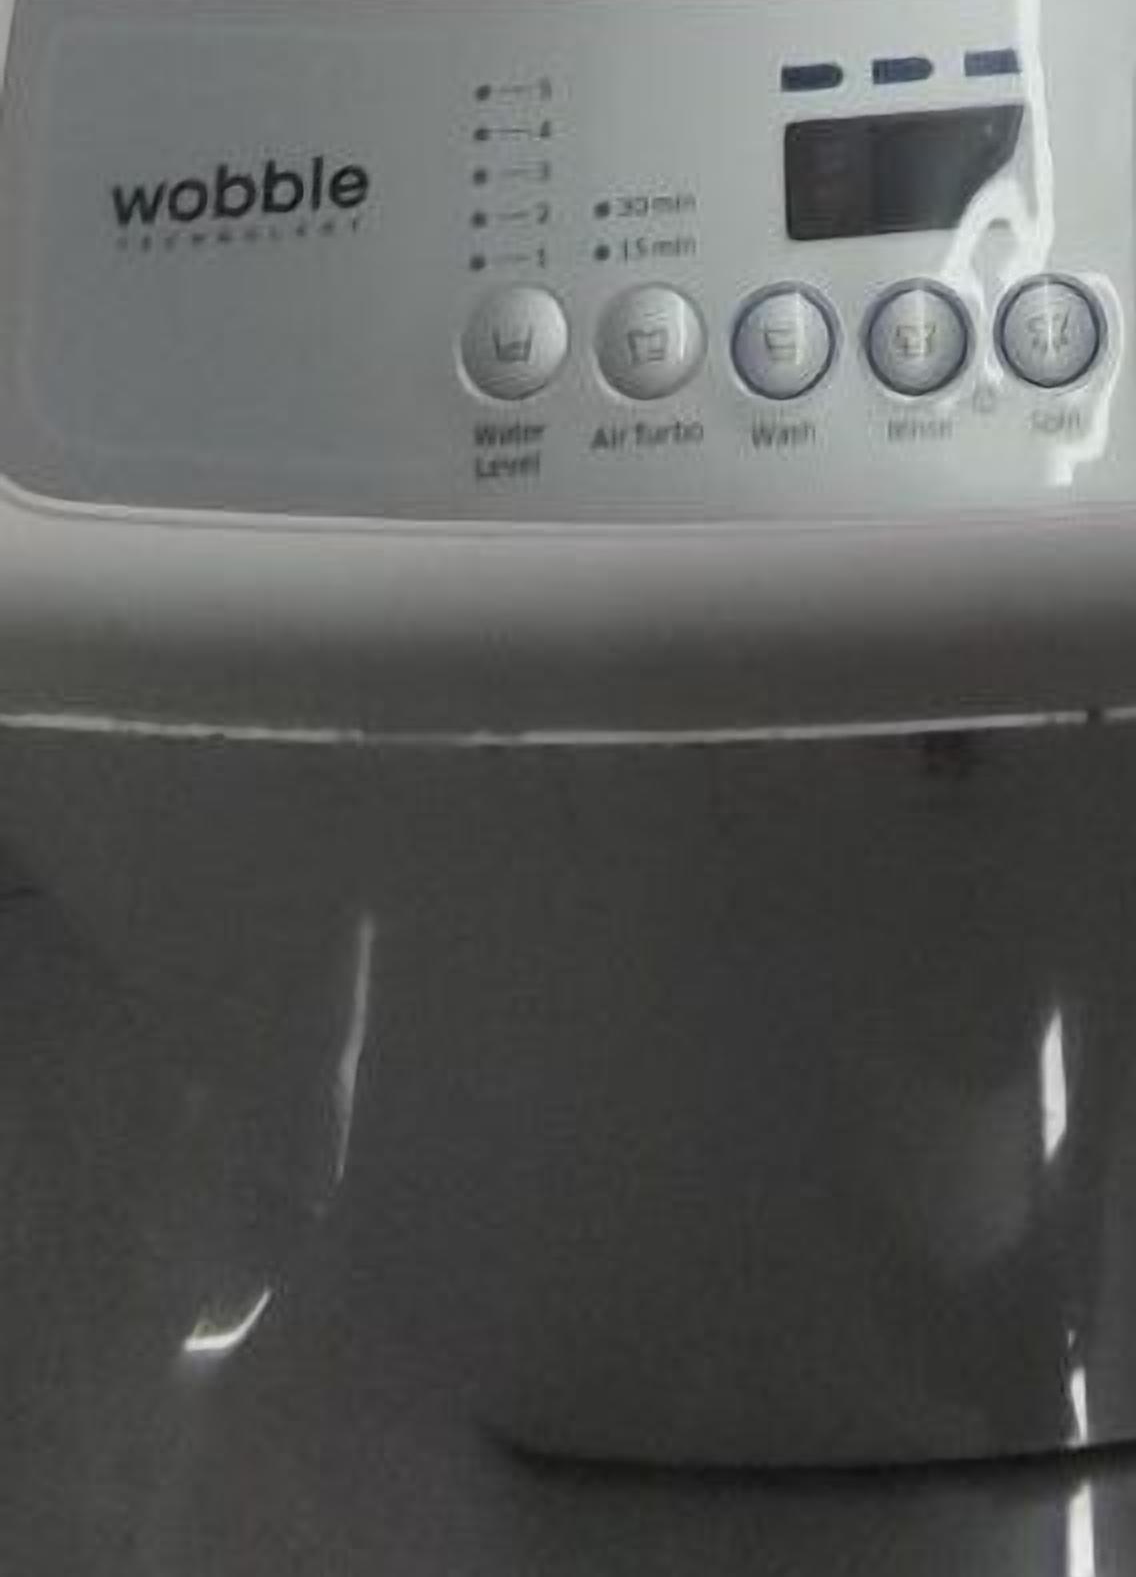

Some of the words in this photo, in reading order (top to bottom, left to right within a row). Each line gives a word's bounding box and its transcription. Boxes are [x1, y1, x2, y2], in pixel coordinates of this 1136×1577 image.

[112, 154, 370, 227] wobble
[475, 423, 546, 446] Water
[751, 421, 816, 447] Wash
[475, 451, 541, 479] Level
